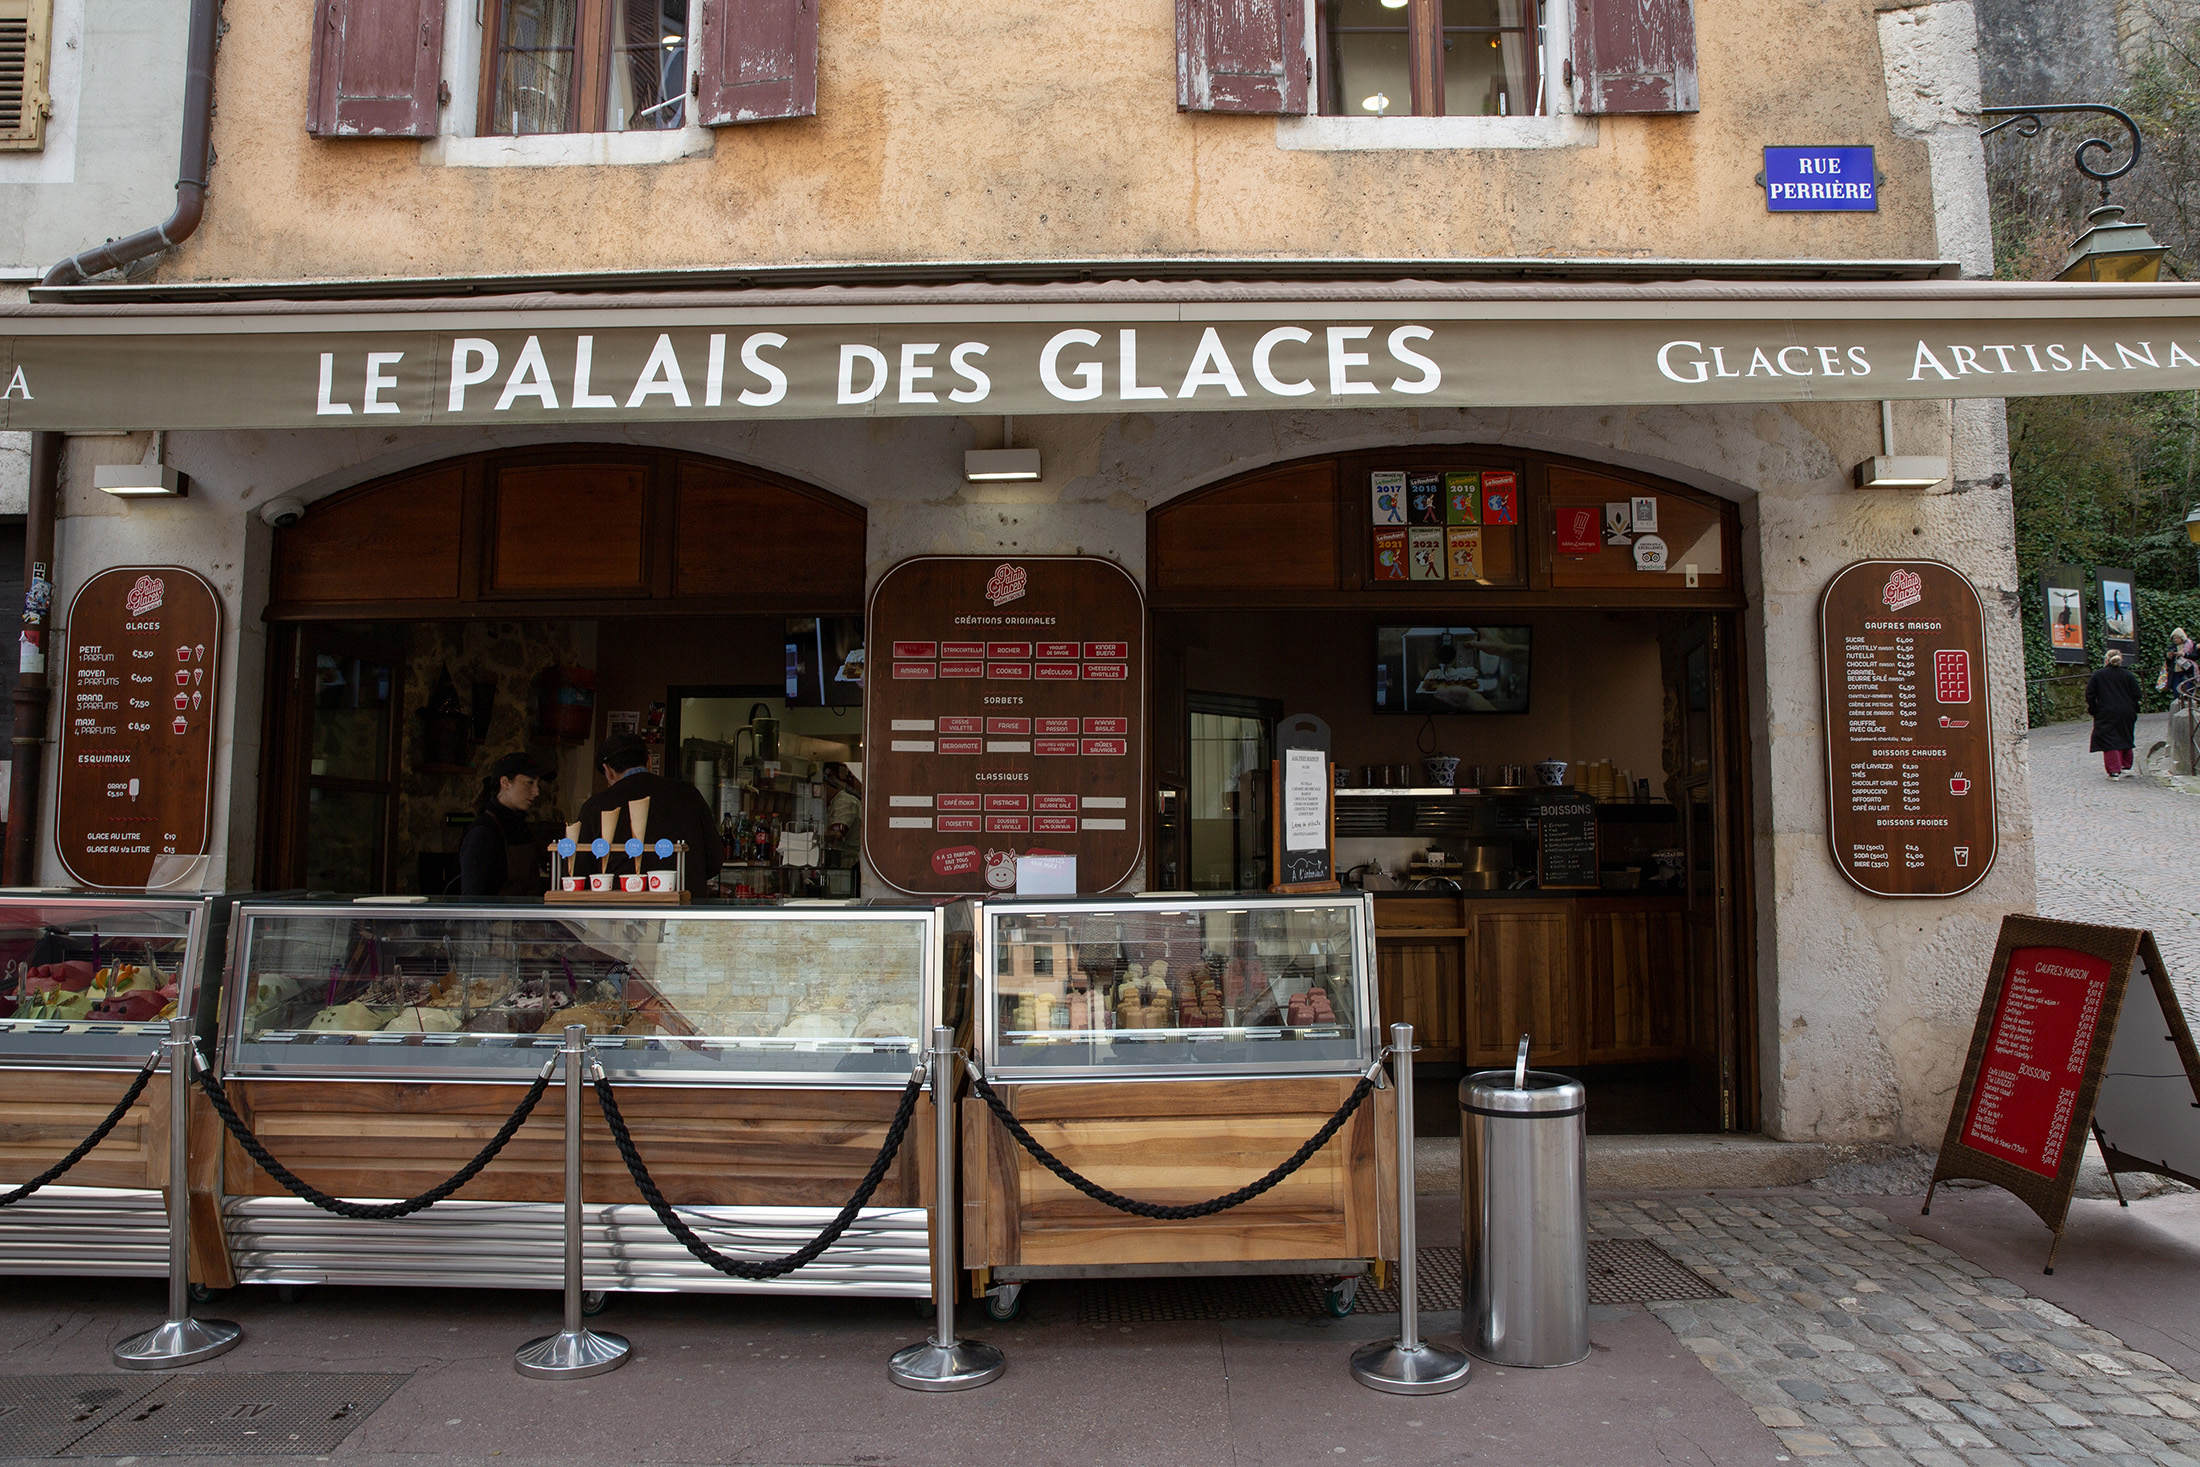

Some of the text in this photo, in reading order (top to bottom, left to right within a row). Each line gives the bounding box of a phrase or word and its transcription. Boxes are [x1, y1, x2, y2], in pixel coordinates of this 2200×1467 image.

[1799, 158, 1841, 174] RUE
[1770, 180, 1872, 199] PERRIÈRE
[1906, 339, 2200, 381] ARTISANA
[316, 325, 1442, 415] LE PALAIS DES GLACES
[954, 615, 1056, 625] CRÉATIONS ORIGINALES
[1865, 622, 1942, 630] GAUFRES MAISON
[84, 677, 120, 686] PARFUMS
[1872, 674, 1887, 682] SALÉ
[77, 694, 103, 702] GRAND
[77, 702, 119, 711] 3 PARFUMS
[75, 718, 96, 726] MAXI
[74, 726, 117, 736] 4 PARFUMS
[78, 755, 131, 763] ESQUIMAUX
[975, 773, 1029, 781] CLASSIQUES
[943, 798, 957, 806] CAFÉ
[1541, 804, 1591, 816] BOISSONS
[953, 850, 976, 858] PARFUMS
[2064, 967, 2089, 980] MAISON
[2018, 1063, 2051, 1082] BOISSONS
[232, 1403, 274, 1419] TV
